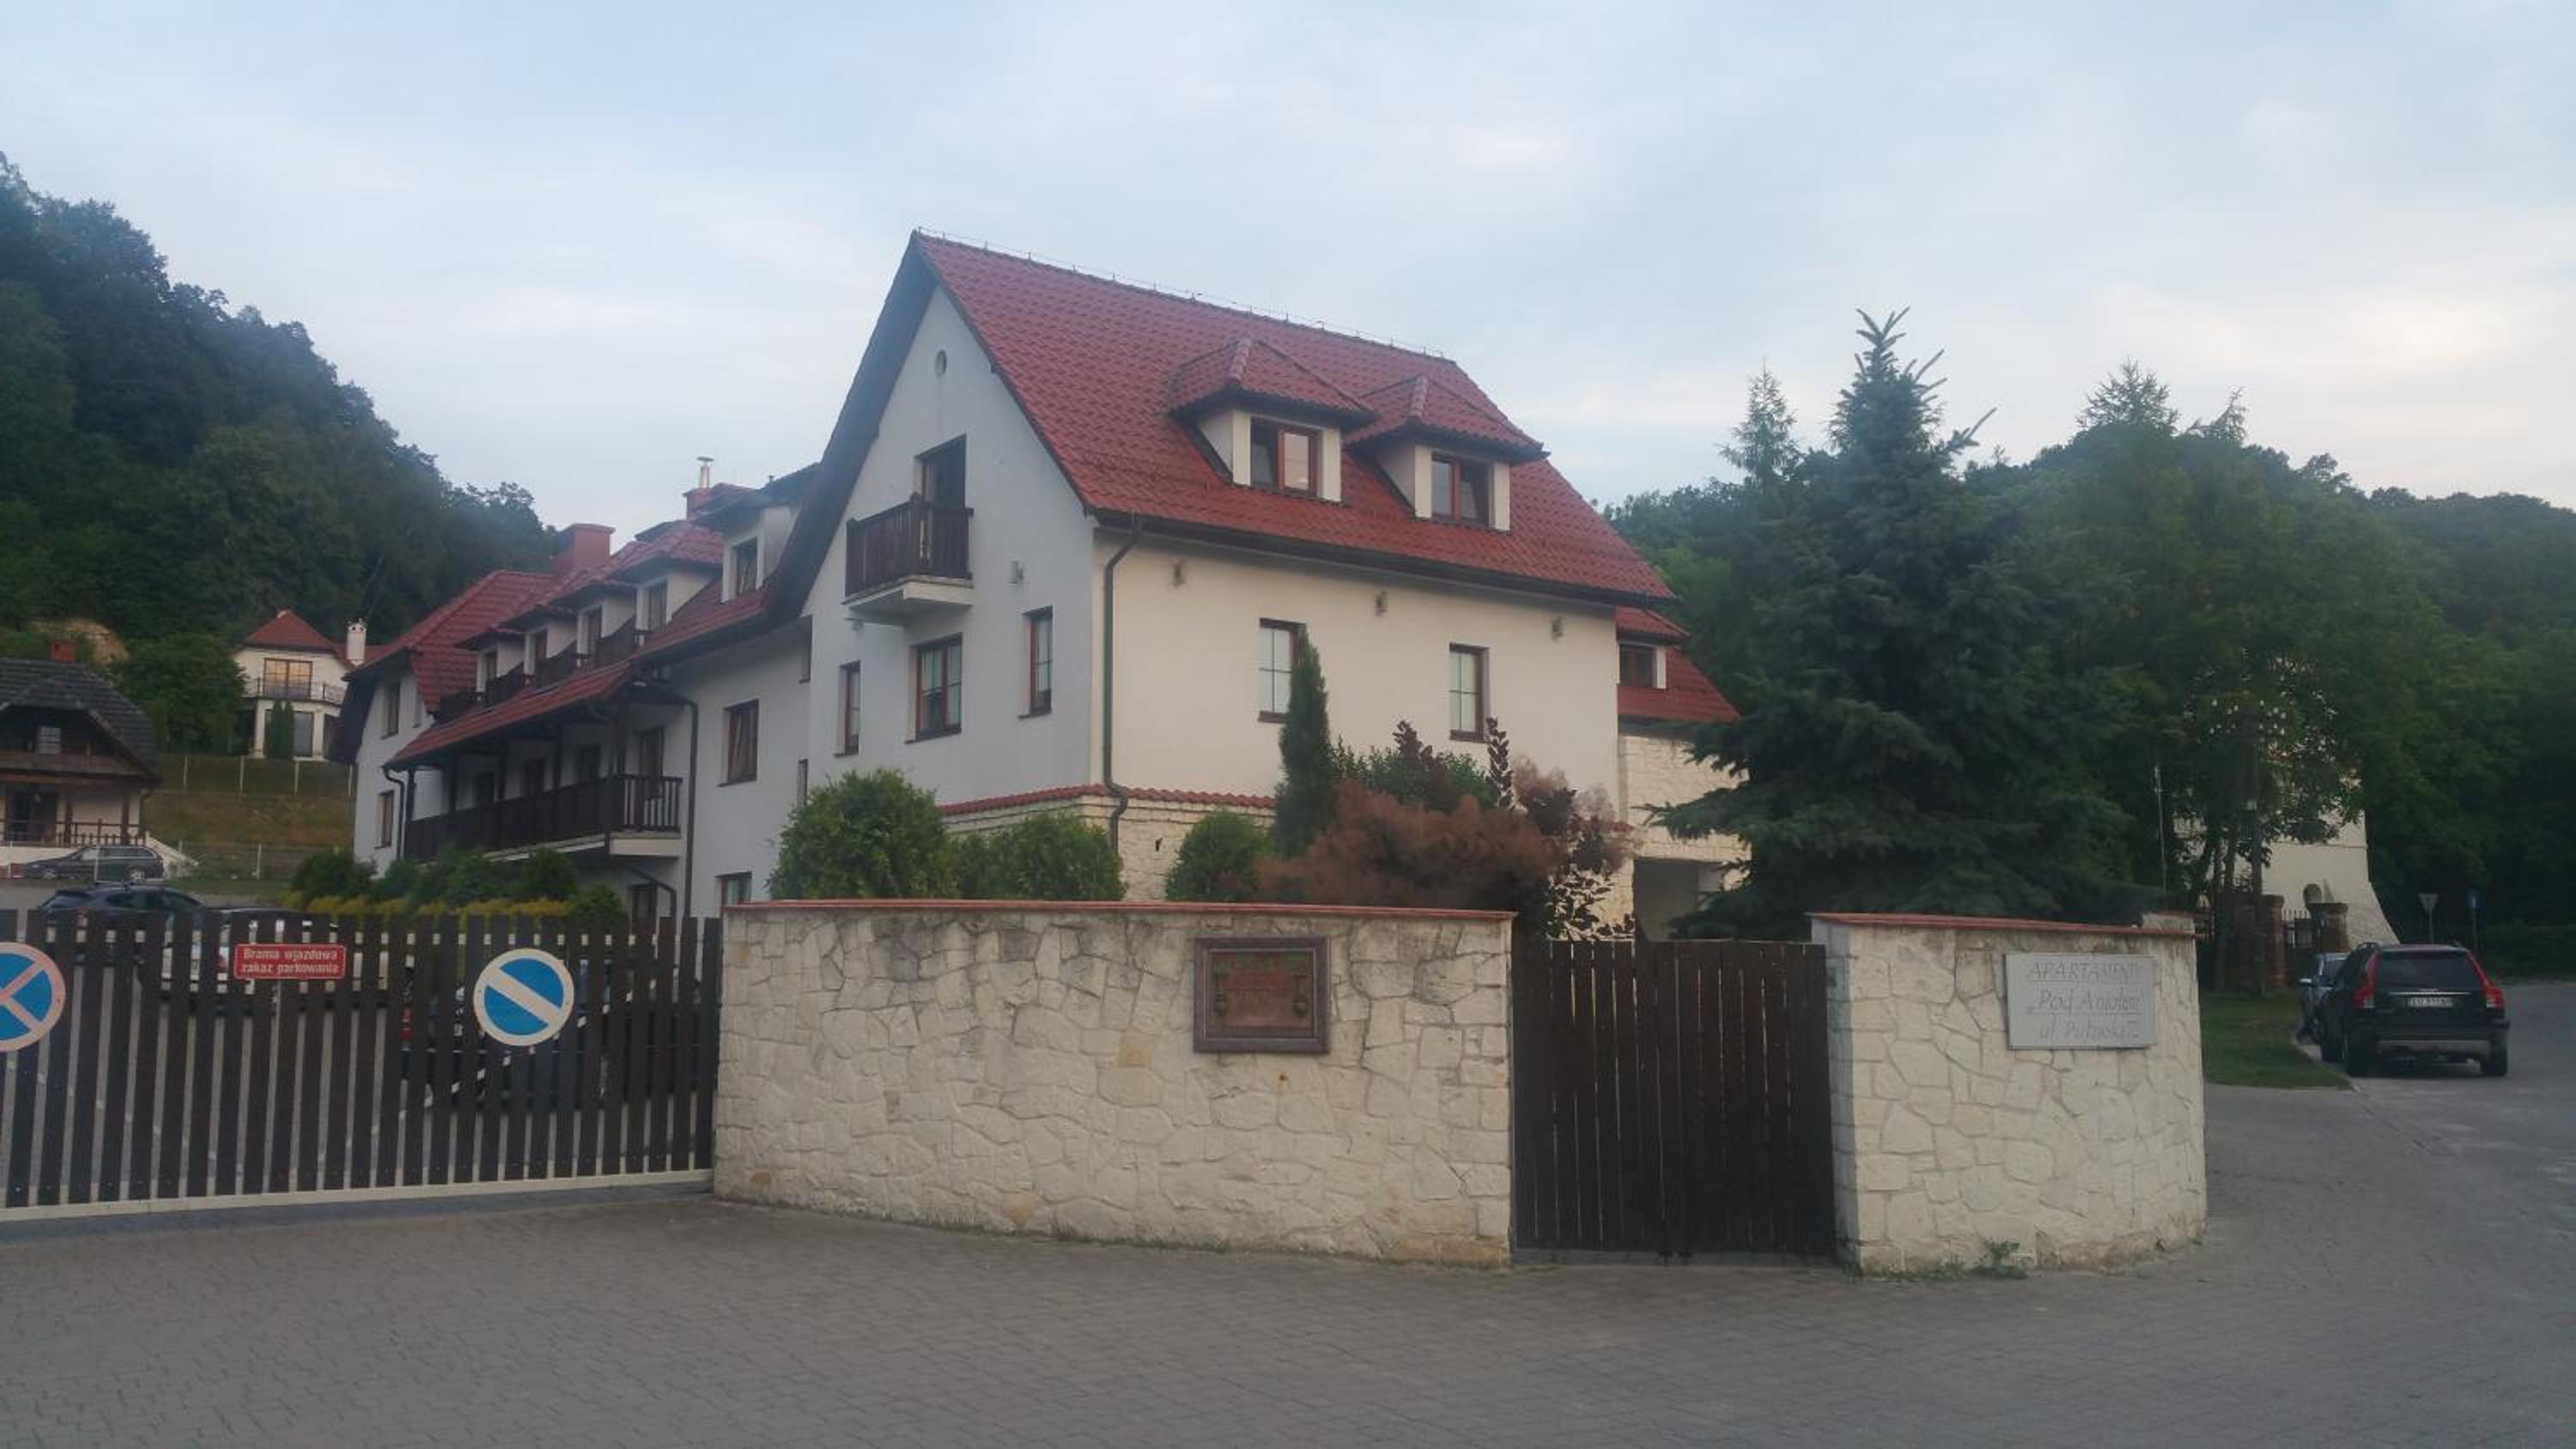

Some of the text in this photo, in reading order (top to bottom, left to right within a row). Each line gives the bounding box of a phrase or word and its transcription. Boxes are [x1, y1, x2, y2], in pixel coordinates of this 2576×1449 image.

[243, 947, 337, 962] Brama wjazdowa
[240, 961, 340, 976] zakaz parkowania
